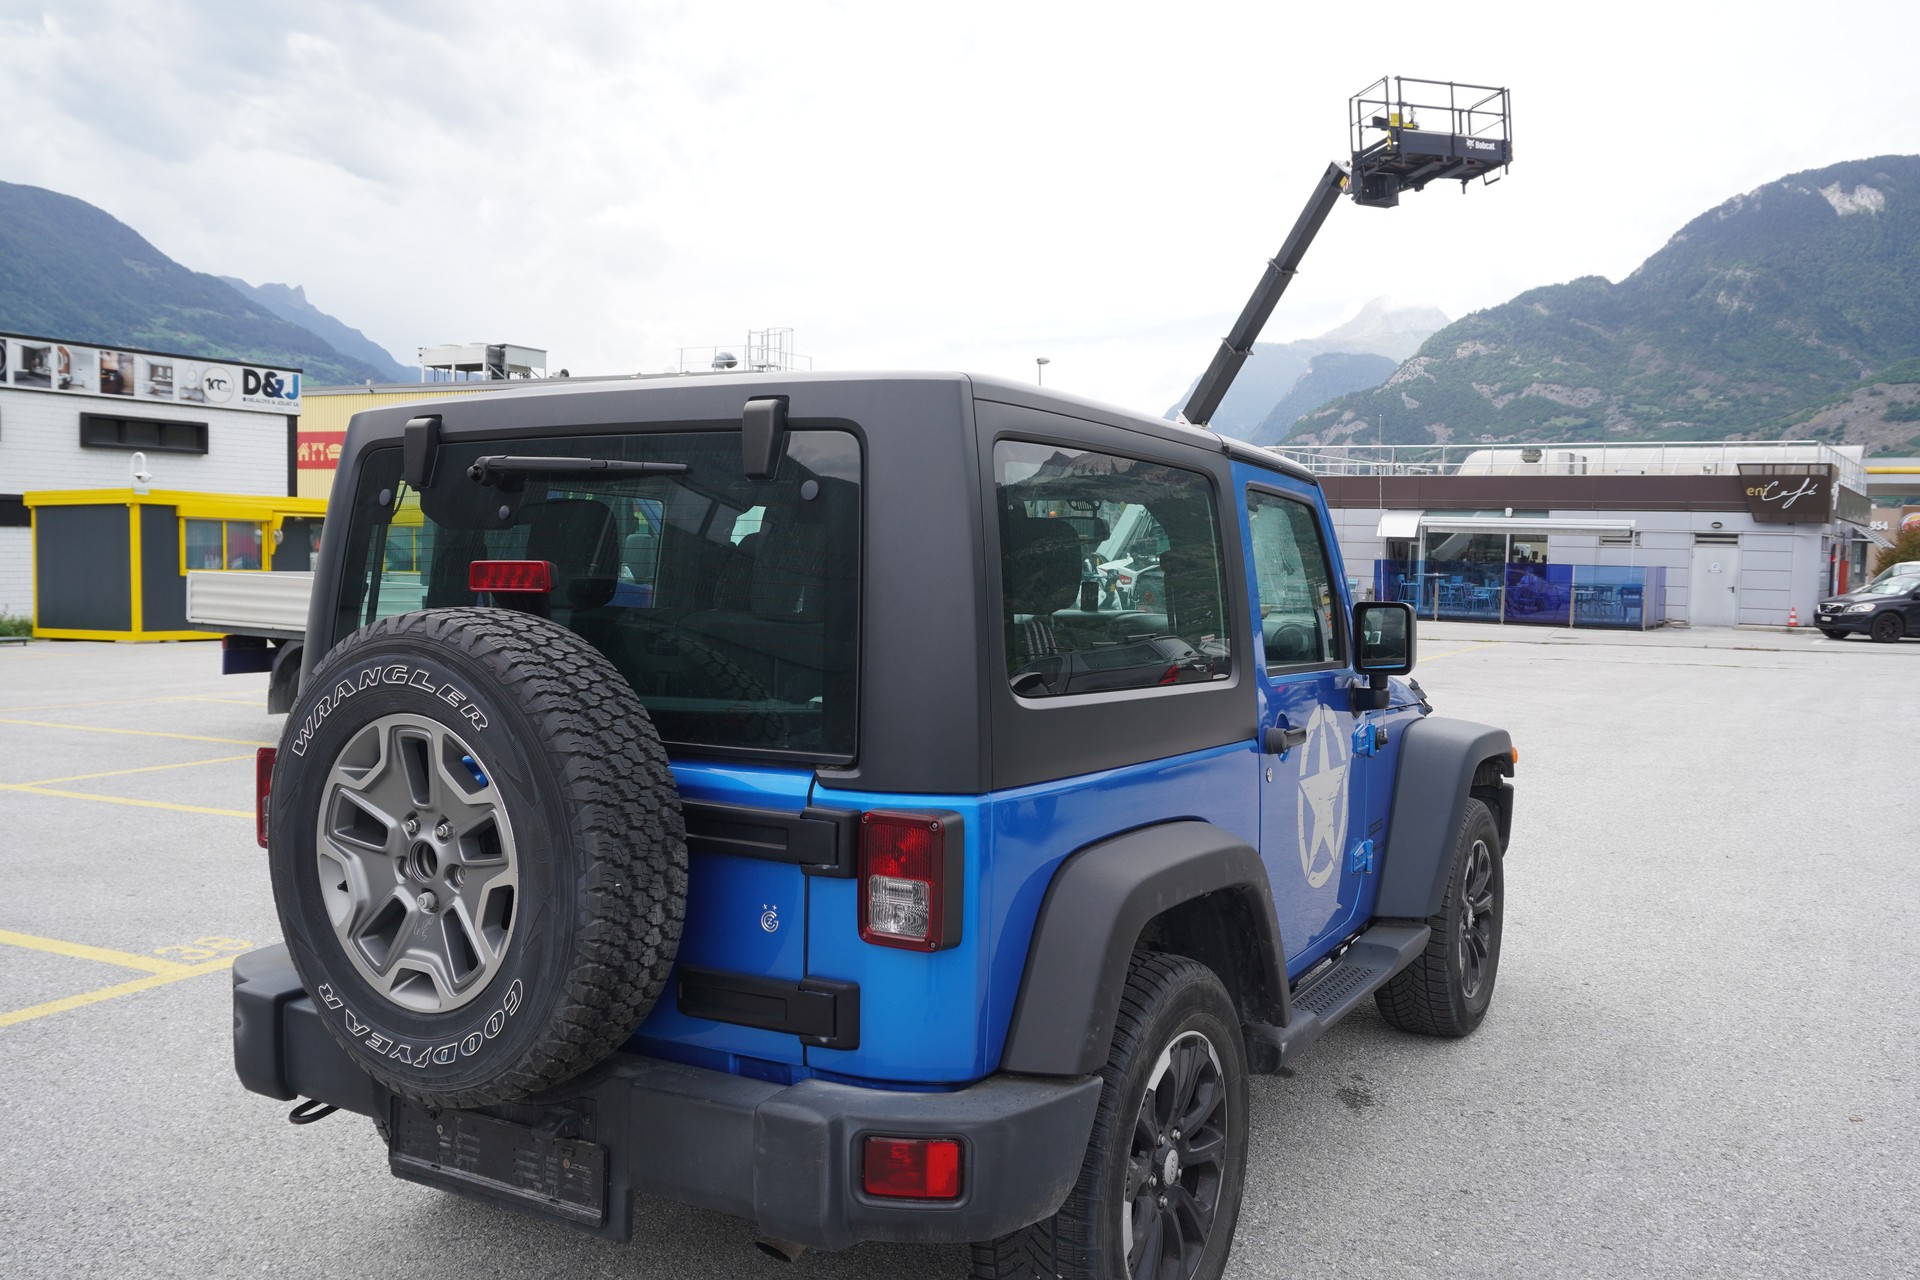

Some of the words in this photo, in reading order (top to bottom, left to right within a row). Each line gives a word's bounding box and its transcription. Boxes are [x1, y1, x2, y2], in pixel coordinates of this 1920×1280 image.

[1475, 140, 1496, 150] Bobcat
[242, 368, 299, 400] D&J
[1746, 484, 1768, 497] eni
[1762, 477, 1819, 509] Café
[291, 664, 488, 756] WRANGLER
[318, 978, 524, 1069] GOODYEAR
